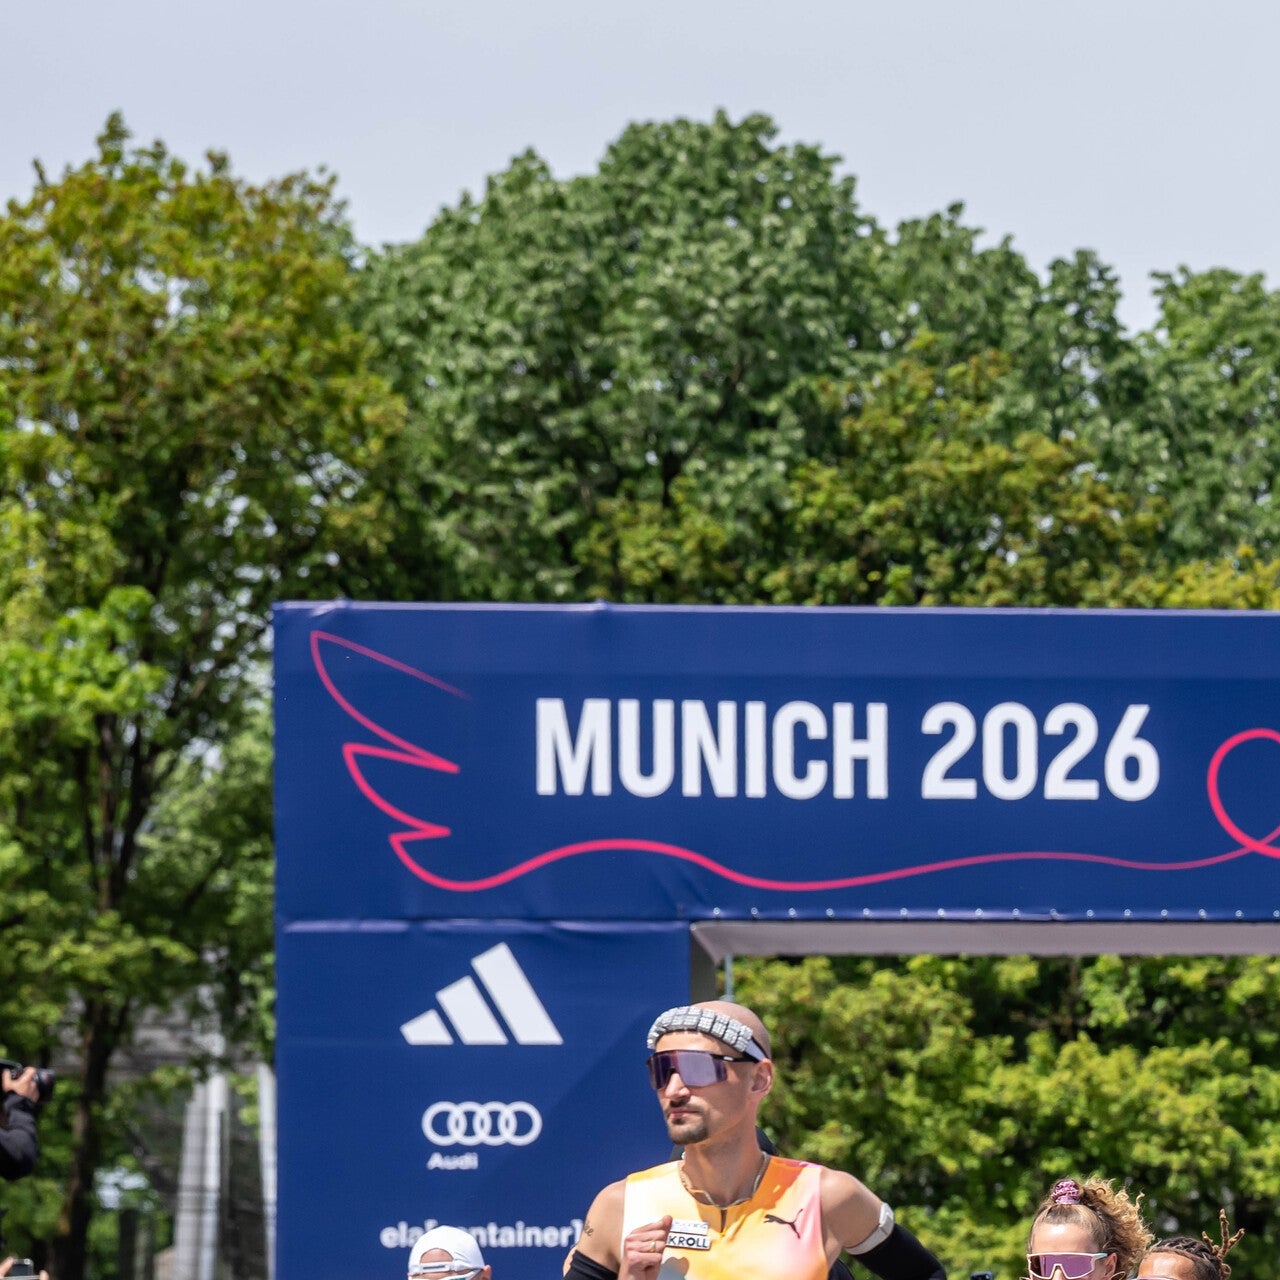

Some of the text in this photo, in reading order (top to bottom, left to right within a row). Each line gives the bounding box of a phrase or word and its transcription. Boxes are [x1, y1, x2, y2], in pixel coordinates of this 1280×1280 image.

[535, 697, 1161, 801] MUNICH 2026
[427, 1152, 478, 1170] Audi
[668, 1235, 708, 1248] KROLL
